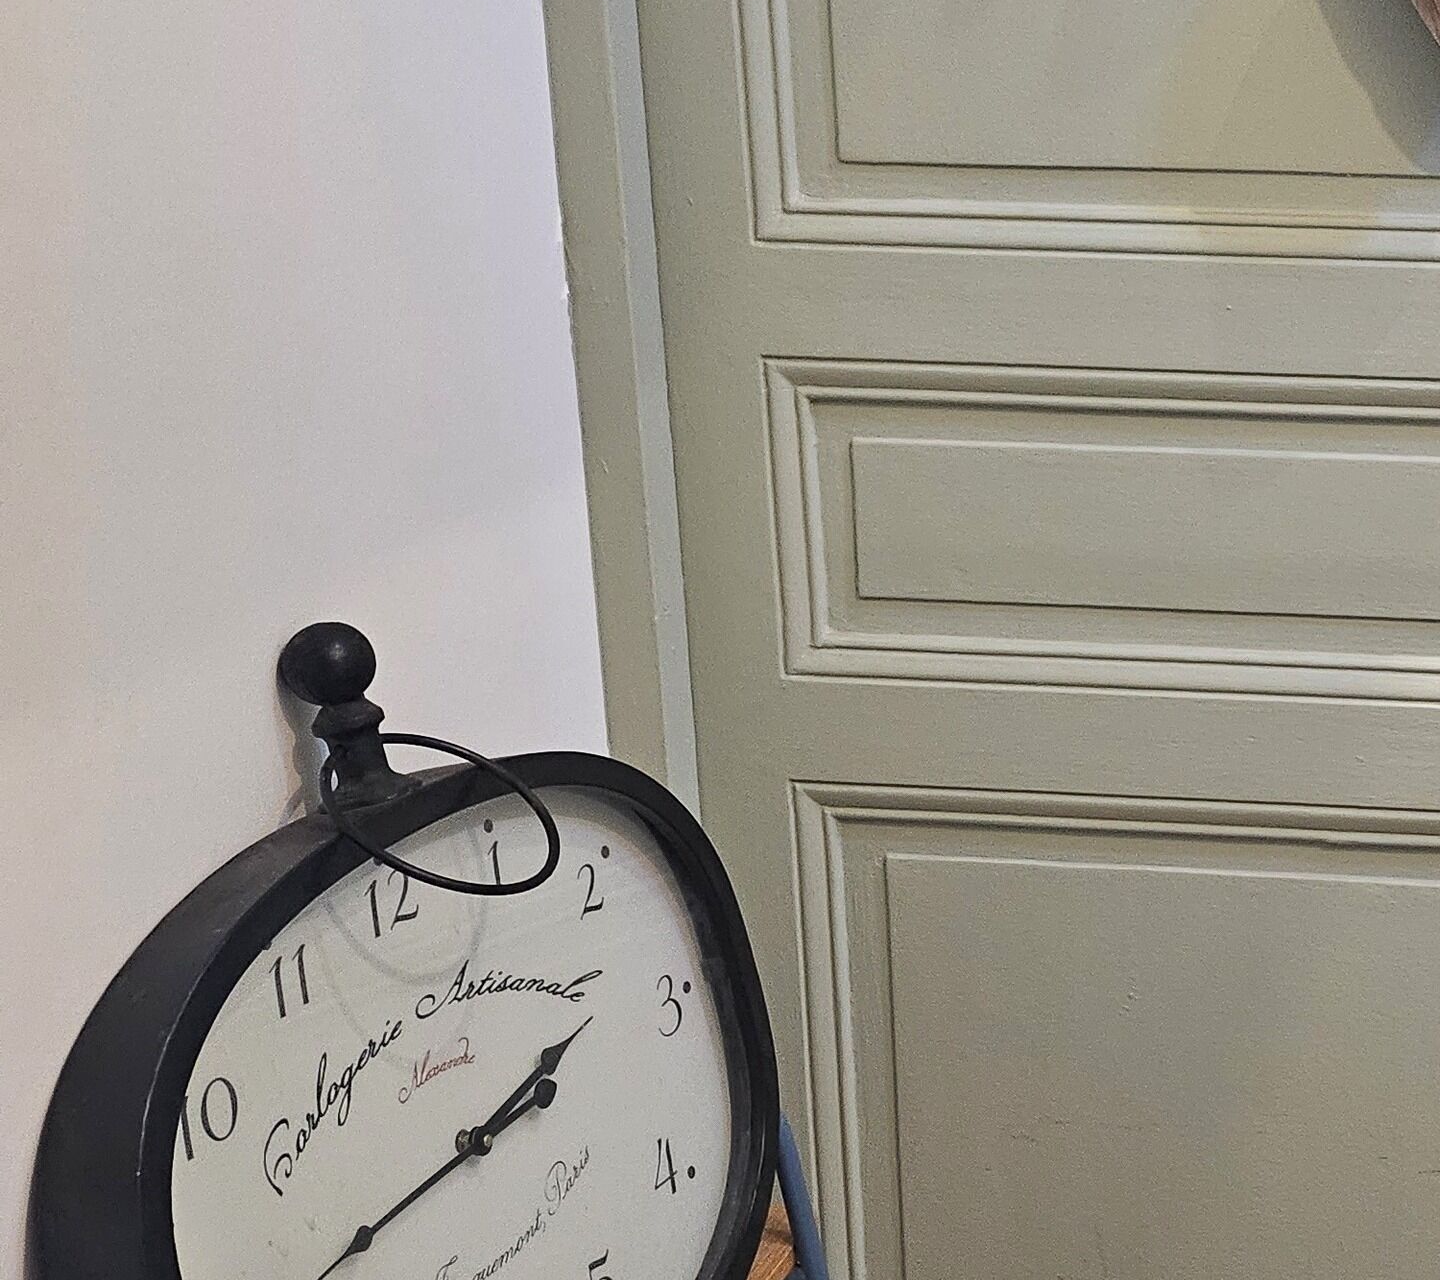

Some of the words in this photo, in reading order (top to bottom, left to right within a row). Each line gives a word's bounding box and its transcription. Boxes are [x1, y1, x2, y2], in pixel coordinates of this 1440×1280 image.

[487, 840, 501, 886] 1
[576, 862, 605, 921] 2
[363, 869, 419, 939] 12
[268, 943, 309, 1019] 11
[414, 958, 604, 1020] Artisanale
[656, 973, 683, 1038] 3
[180, 1076, 238, 1162] 10
[543, 1144, 590, 1216] Paris
[654, 1137, 678, 1195] 4
